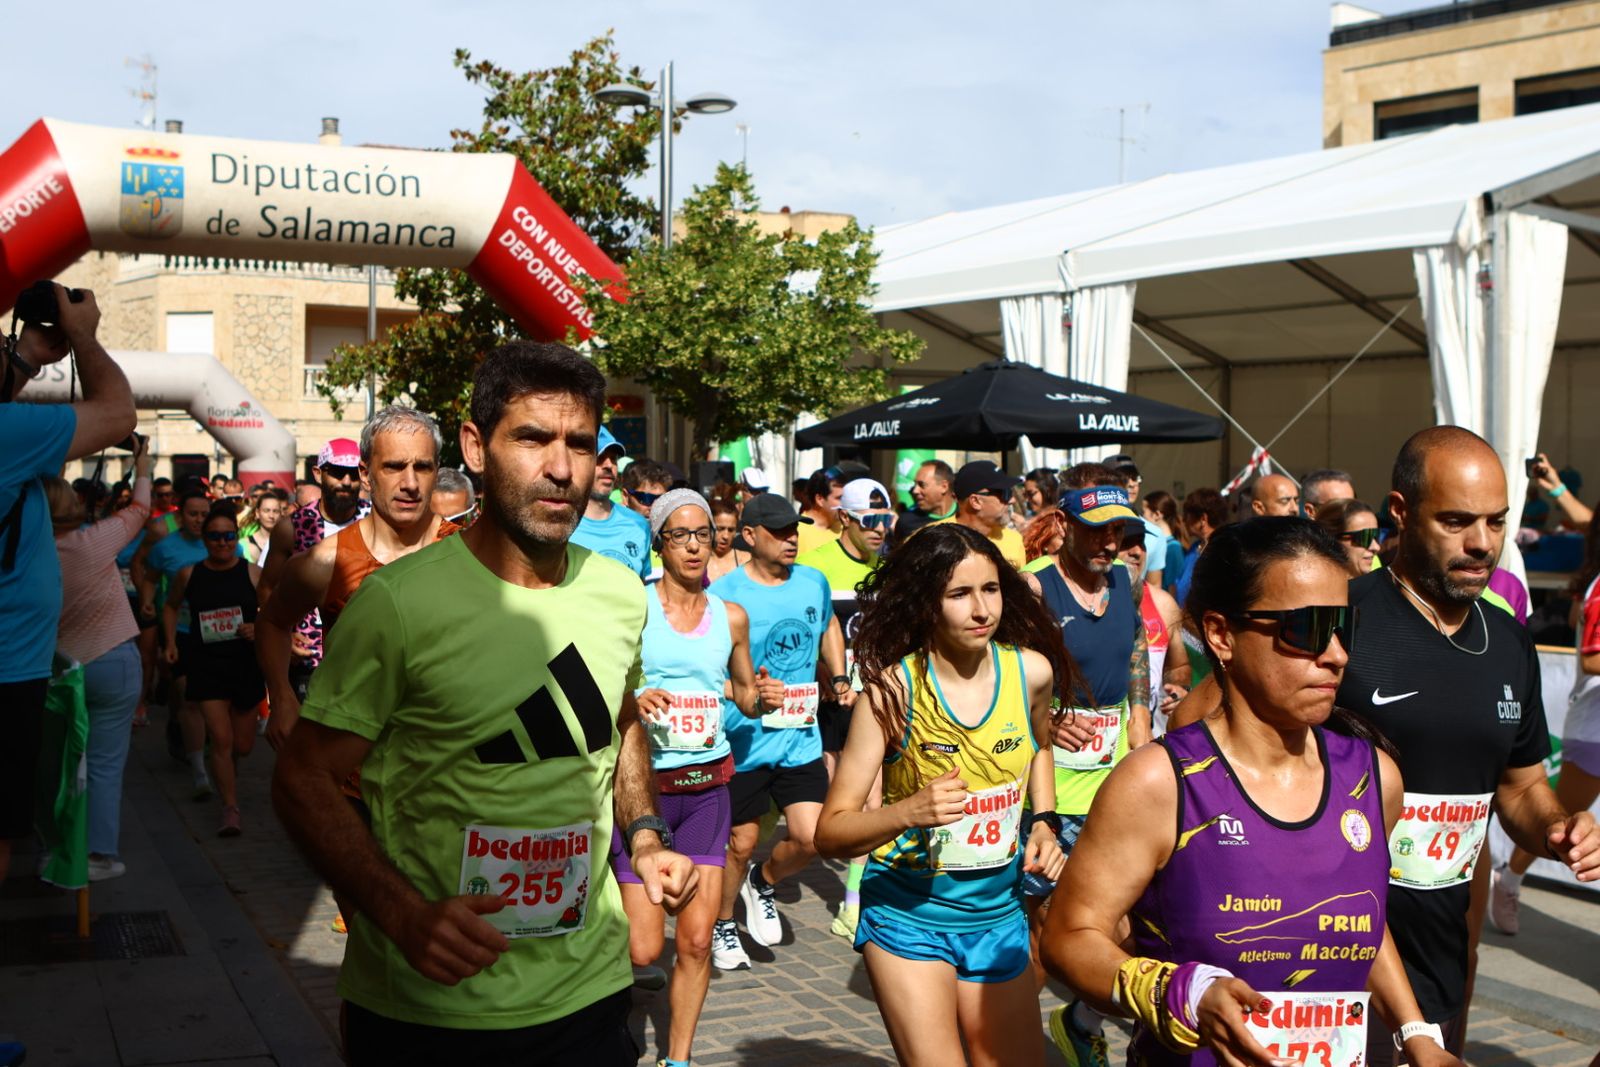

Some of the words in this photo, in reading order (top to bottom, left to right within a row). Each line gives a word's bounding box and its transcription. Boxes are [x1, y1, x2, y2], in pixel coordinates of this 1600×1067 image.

[211, 153, 421, 197] Diputación
[206, 209, 240, 236] de
[257, 205, 457, 249] Salamanca
[512, 205, 548, 244] CON
[498, 229, 595, 328] DEPORTISTAS
[854, 423, 868, 439] LA
[868, 420, 900, 437] SALVE
[1079, 413, 1098, 430] LA
[1098, 413, 1140, 432] SALVE
[211, 620, 234, 633] 166
[780, 703, 805, 716] 146
[1497, 701, 1521, 719] CUZCO
[669, 715, 704, 733] 153
[967, 820, 1001, 846] 48
[468, 831, 589, 862] bedunia
[1427, 831, 1460, 860] 49
[498, 870, 565, 906] 255
[1218, 894, 1282, 912] Jamón
[1318, 914, 1371, 932] PRIM
[1238, 950, 1291, 963] Atletismo
[1300, 943, 1376, 962] Macotera
[1240, 998, 1363, 1028] edunia
